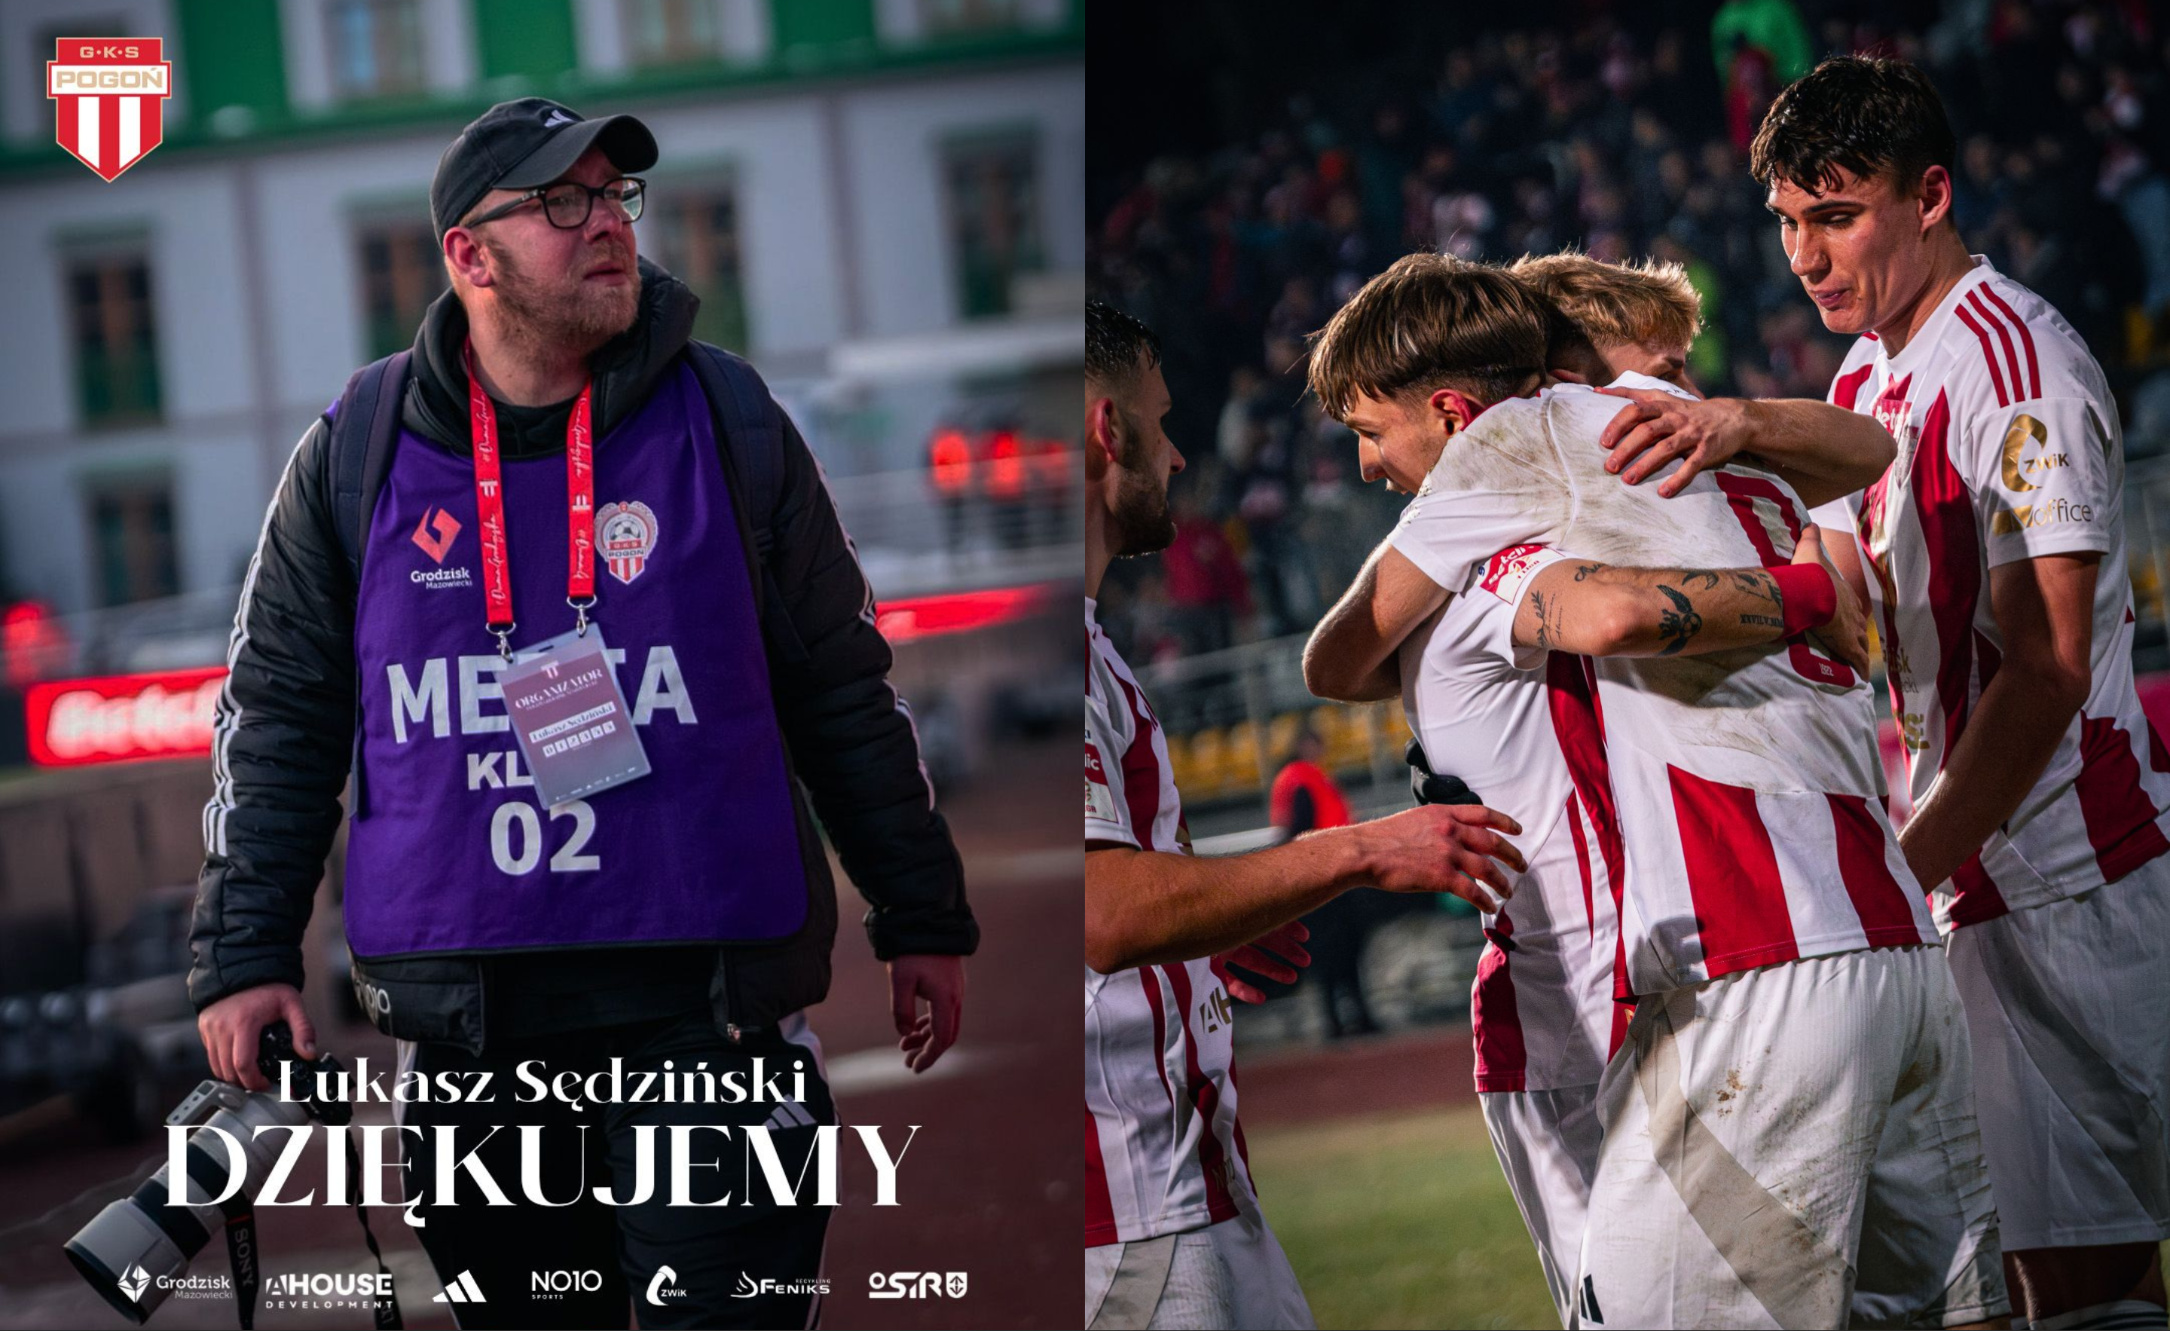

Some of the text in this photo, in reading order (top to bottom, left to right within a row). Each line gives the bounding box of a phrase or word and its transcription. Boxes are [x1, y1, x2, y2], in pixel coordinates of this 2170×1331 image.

[410, 567, 470, 583] Grodzisk
[425, 580, 473, 589] Mazowiecki
[490, 800, 600, 876] 02
[234, 1228, 254, 1287] SONY
